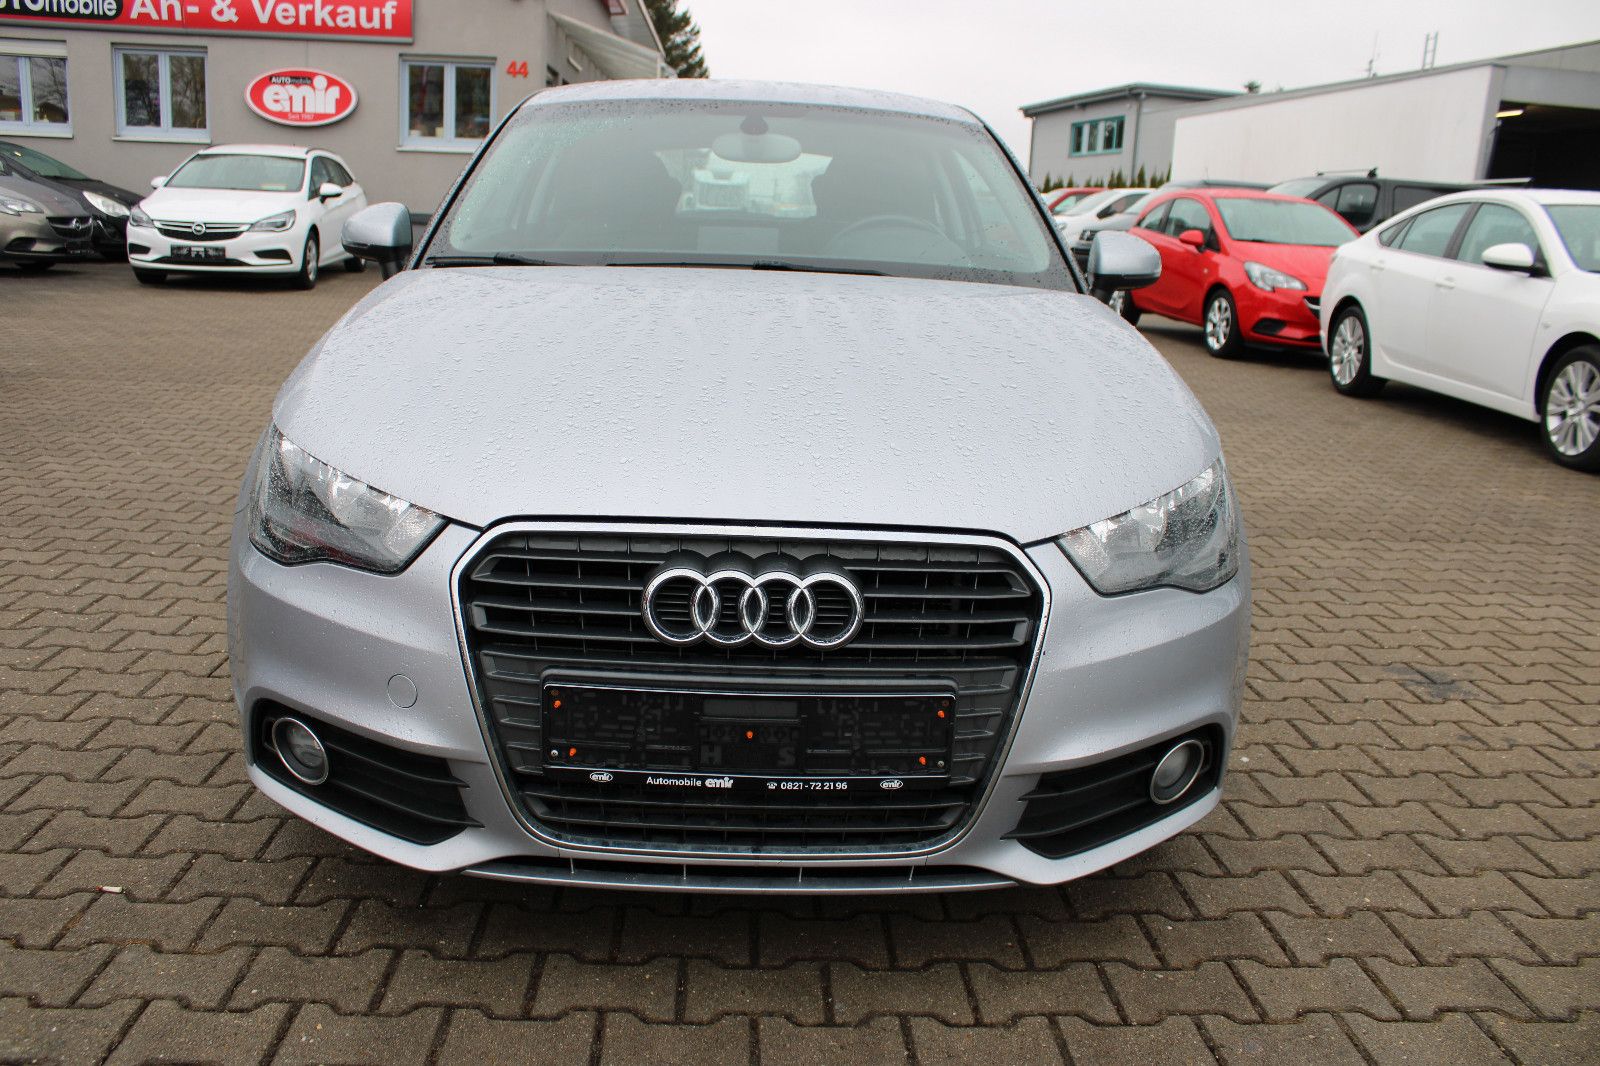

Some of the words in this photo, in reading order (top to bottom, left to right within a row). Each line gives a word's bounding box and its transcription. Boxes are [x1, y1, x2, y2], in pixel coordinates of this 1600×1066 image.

[130, 0, 199, 22] An-
[211, 0, 239, 23] &
[252, 0, 397, 30] Verkauf
[506, 60, 528, 78] 44
[263, 75, 340, 114] emir
[646, 777, 702, 787] Automobile
[705, 777, 734, 789] emir
